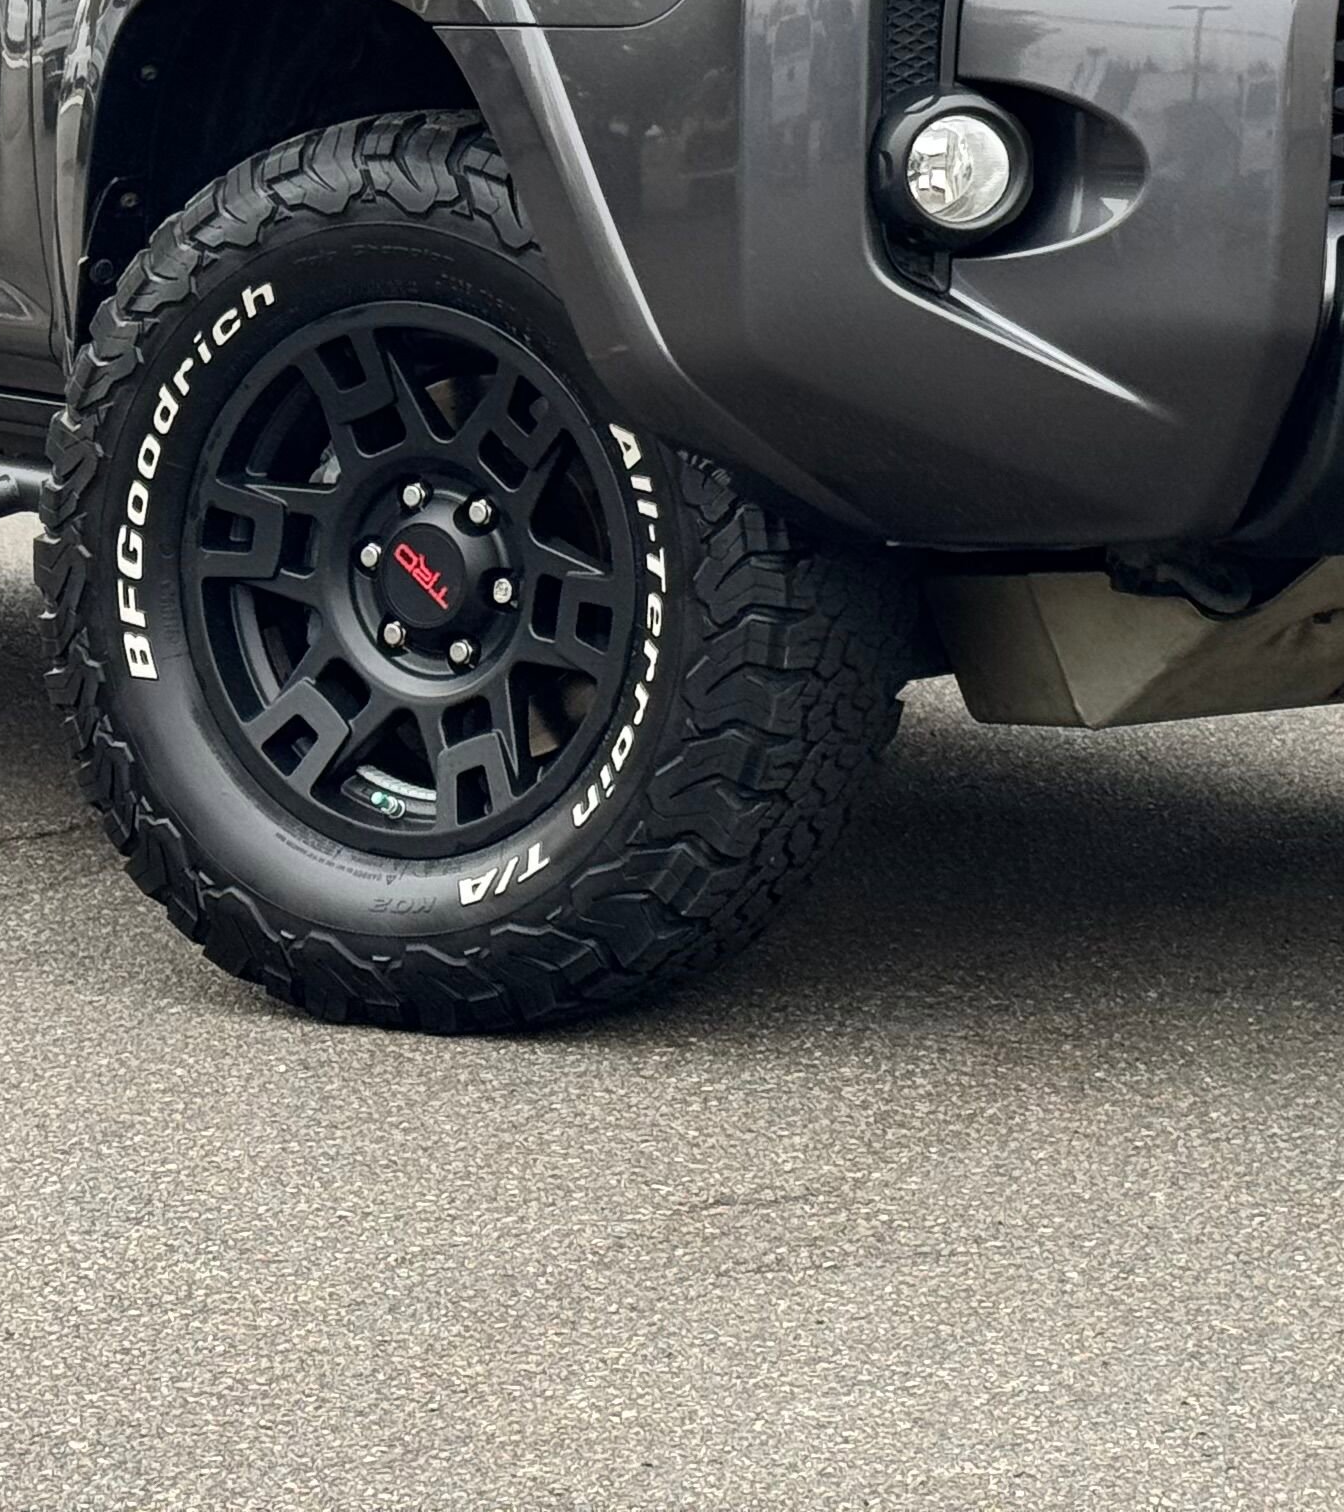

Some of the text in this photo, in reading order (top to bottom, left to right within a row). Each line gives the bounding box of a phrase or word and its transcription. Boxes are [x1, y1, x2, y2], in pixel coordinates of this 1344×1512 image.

[117, 281, 276, 680] BFGoodrich
[394, 543, 449, 609] TRD
[458, 423, 667, 907] All-Terrain T/A
